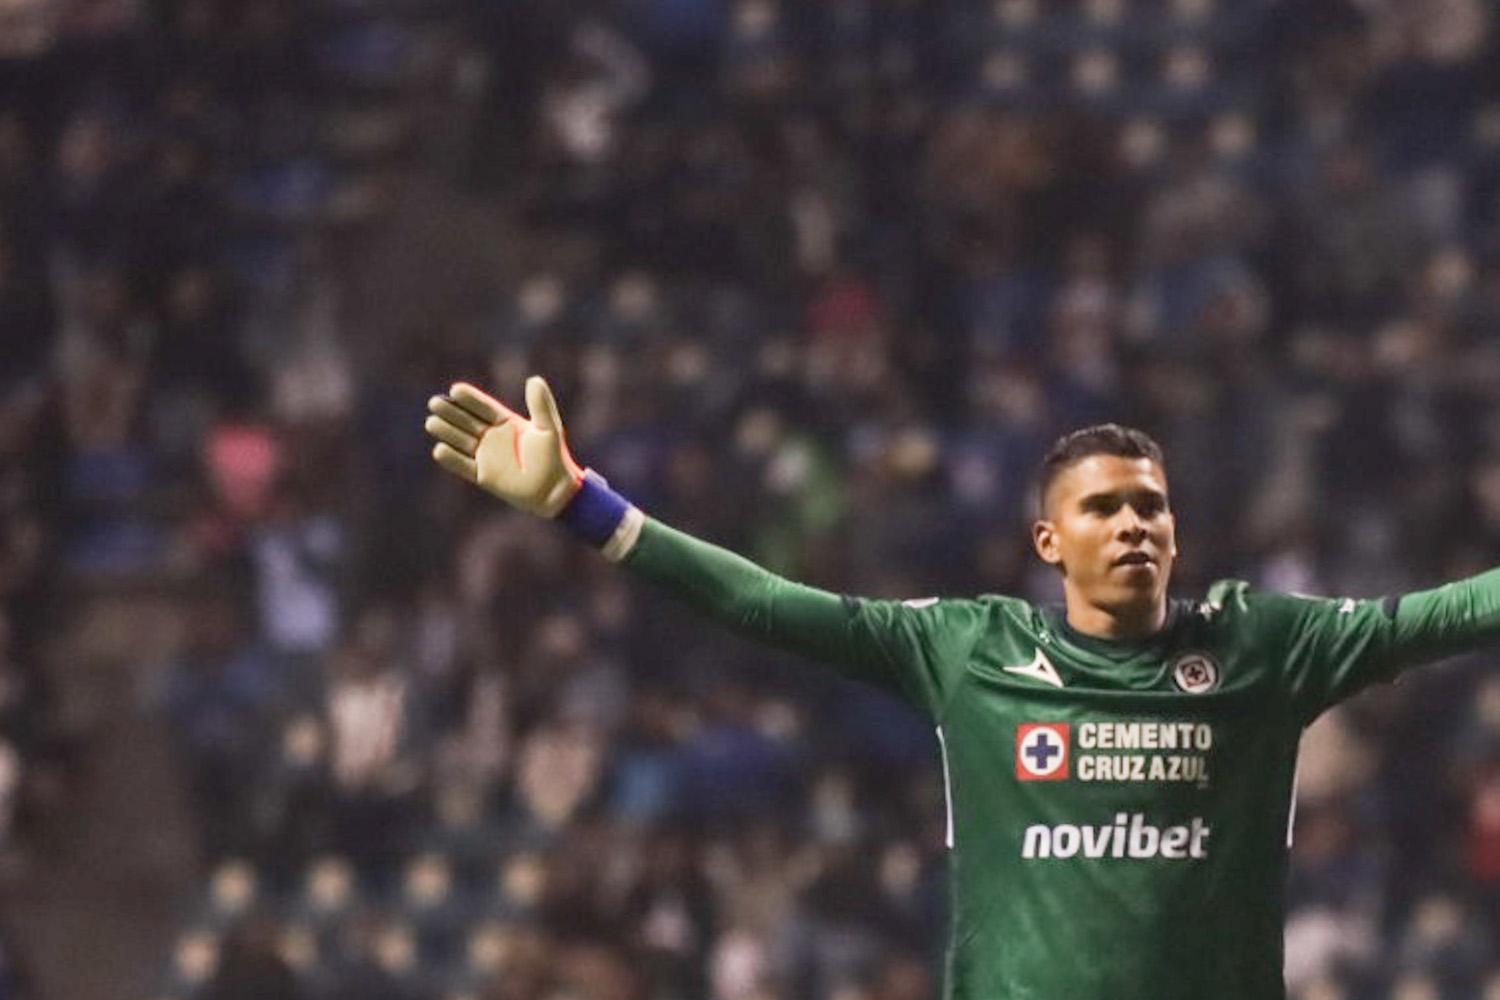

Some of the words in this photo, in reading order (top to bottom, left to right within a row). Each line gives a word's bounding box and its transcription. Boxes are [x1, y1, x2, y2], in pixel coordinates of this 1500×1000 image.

[1078, 723, 1212, 749] CEMENTO
[1078, 755, 1146, 781] CRUZ
[1149, 755, 1209, 781] AZUL
[1021, 812, 1210, 859] novibet
